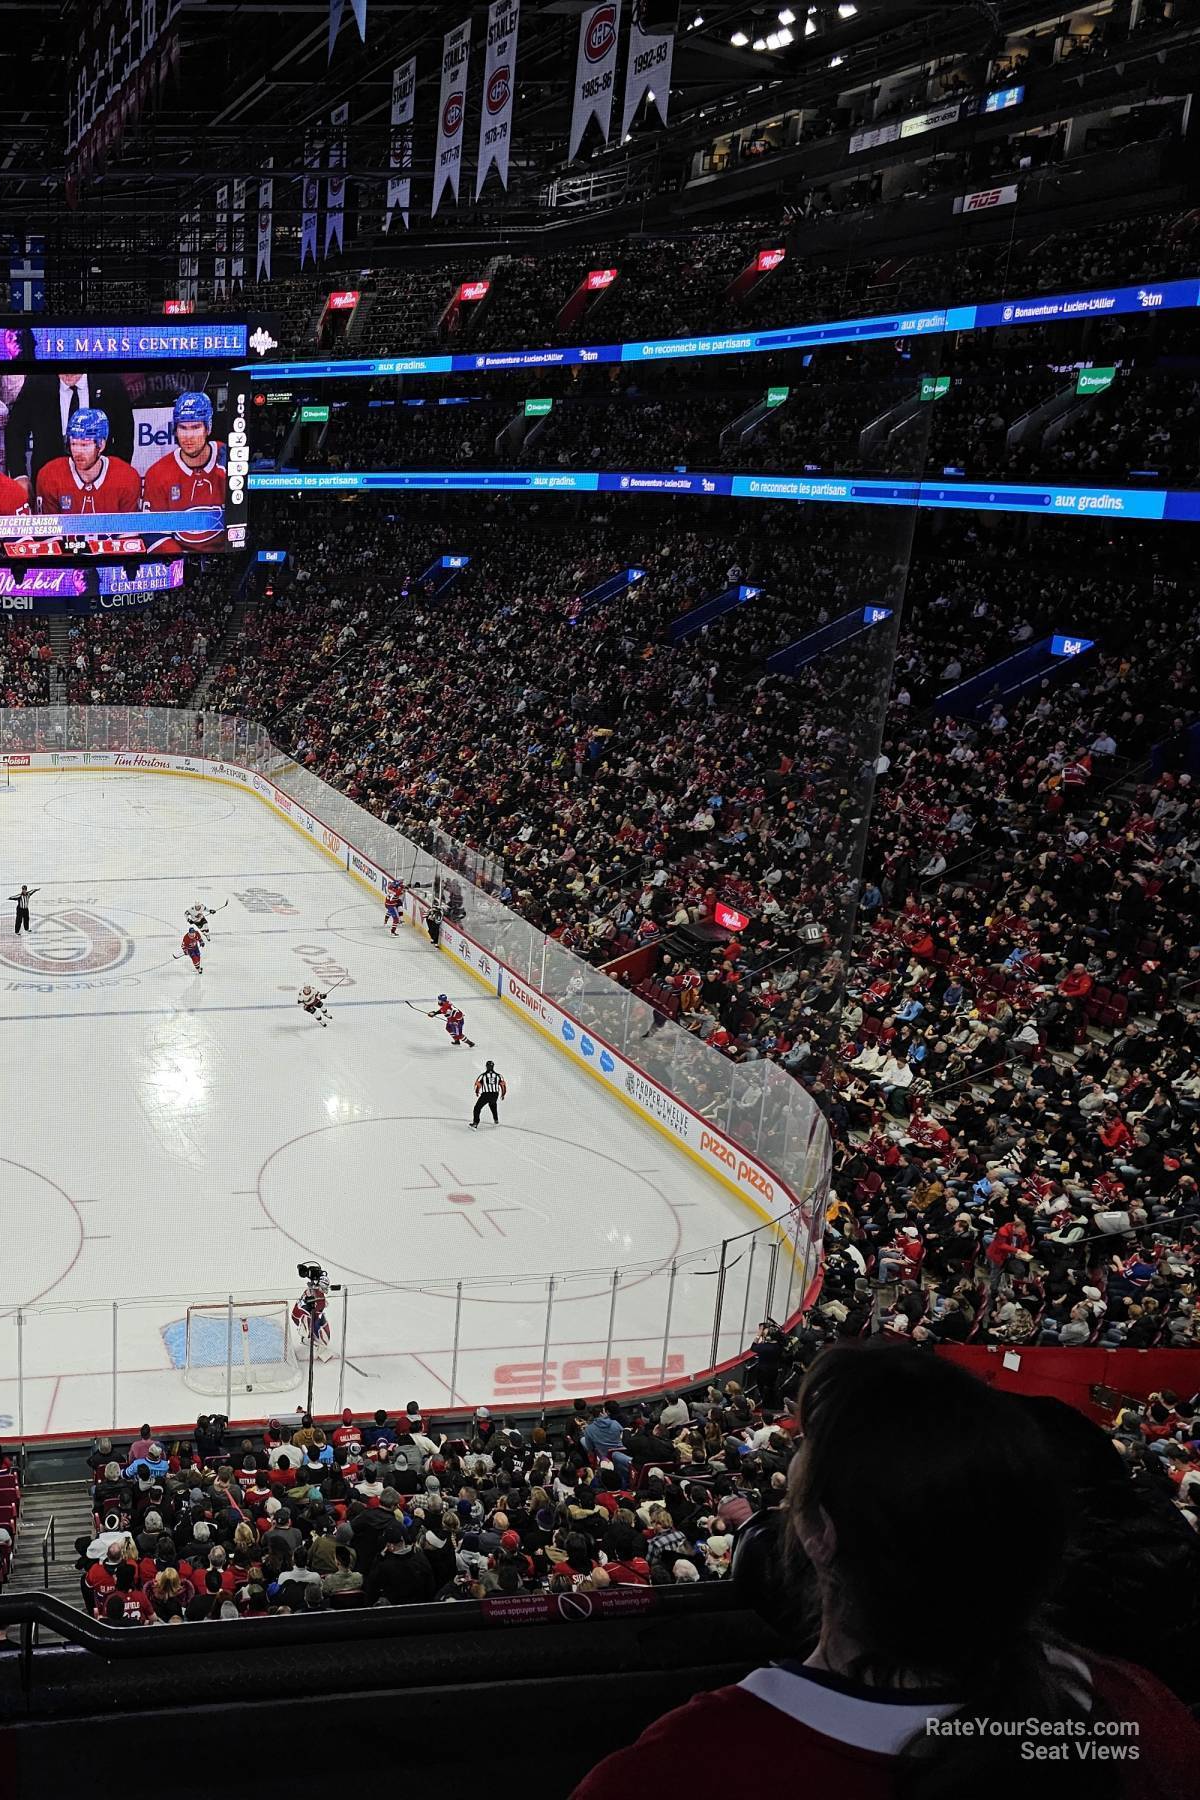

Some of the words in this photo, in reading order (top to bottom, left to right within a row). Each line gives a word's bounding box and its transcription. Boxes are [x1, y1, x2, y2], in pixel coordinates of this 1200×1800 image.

[634, 42, 668, 75] 1992-93
[581, 70, 613, 101] 1985-86
[1141, 291, 1163, 307] stm
[1015, 304, 1058, 318] Bonaventure
[46, 338, 65, 353] 18
[75, 337, 131, 352] MARS
[138, 336, 199, 351] CENTRE
[203, 334, 242, 350] BELL
[642, 344, 654, 356] On
[655, 341, 697, 354] reconnecte
[698, 339, 711, 351] les
[712, 336, 751, 353] partisans
[901, 318, 916, 330] aux
[486, 355, 521, 365] Bonaventure
[582, 349, 599, 361] stm
[378, 361, 394, 372] aux
[395, 359, 427, 373] gradins.
[257, 475, 303, 486] reconnecte
[304, 475, 317, 485] les
[318, 475, 359, 487] partisans
[534, 477, 548, 486] aux
[548, 475, 577, 488] gradins.
[750, 481, 760, 492] On
[761, 481, 798, 494] reconnecte
[799, 482, 811, 495] les
[811, 483, 847, 498] partisans
[1055, 495, 1076, 508] aux
[1078, 494, 1125, 511] gradins.
[114, 754, 134, 766] Tim
[134, 755, 170, 769] Hortons
[808, 927, 819, 940] 10
[700, 1131, 736, 1170] pizza
[738, 1161, 773, 1203] pizza
[489, 1608, 506, 1617] vous
[507, 1606, 535, 1617] appuyer
[536, 1604, 549, 1613] sur
